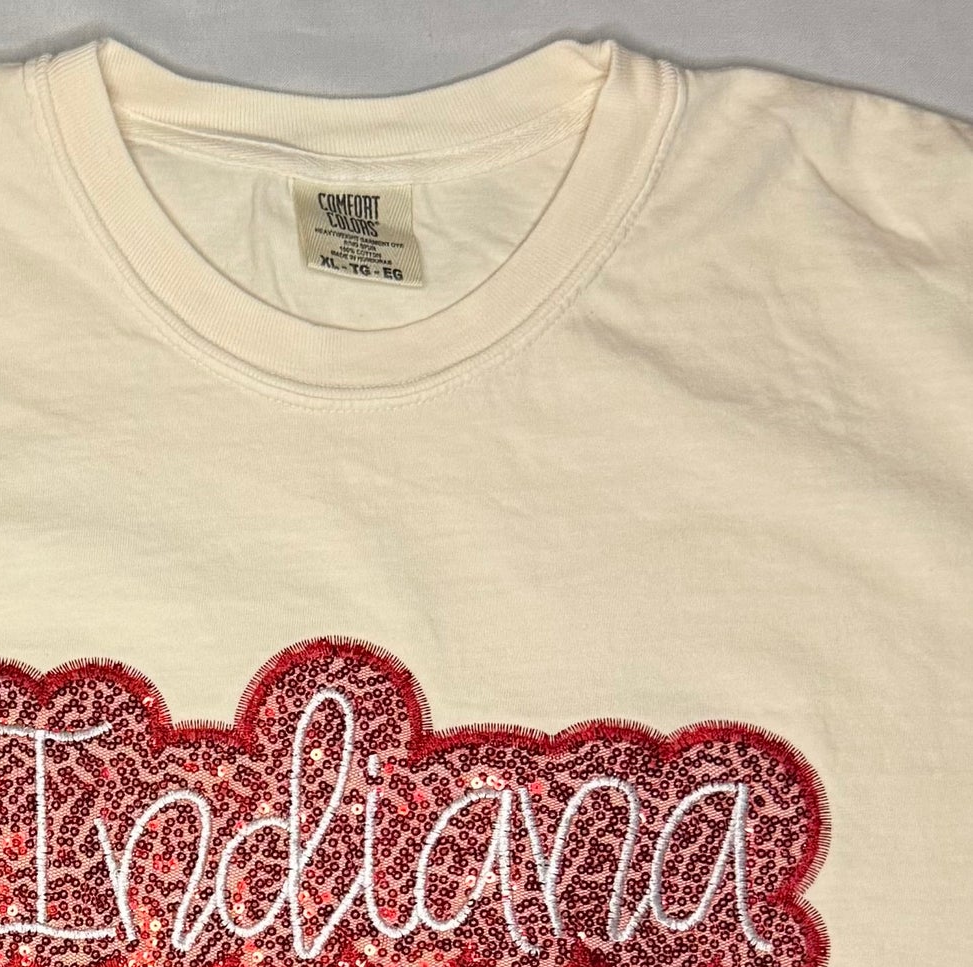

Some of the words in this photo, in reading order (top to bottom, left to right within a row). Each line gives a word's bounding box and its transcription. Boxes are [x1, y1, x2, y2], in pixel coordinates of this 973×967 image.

[318, 193, 381, 220] COMFORT
[320, 255, 339, 270] XL
[349, 263, 371, 276] TG
[383, 267, 403, 281] EG
